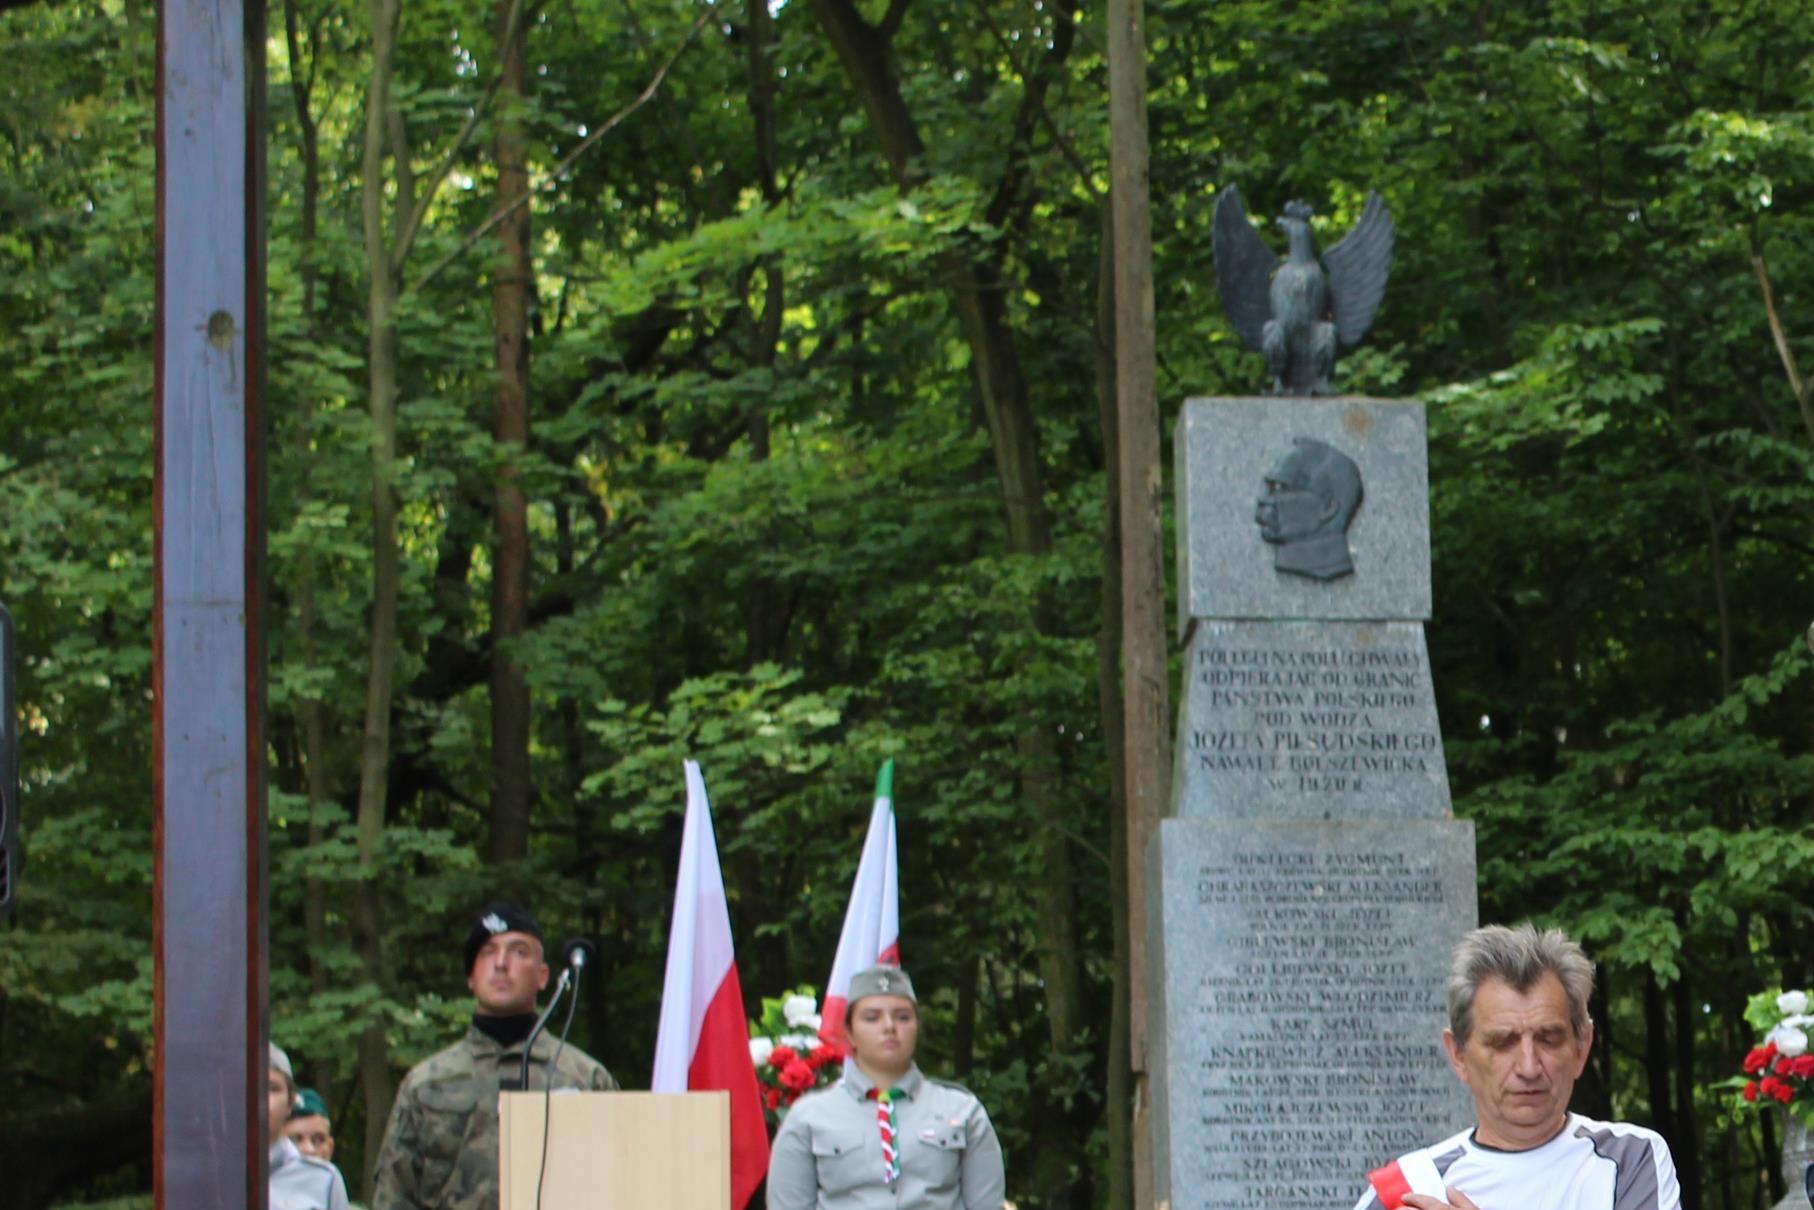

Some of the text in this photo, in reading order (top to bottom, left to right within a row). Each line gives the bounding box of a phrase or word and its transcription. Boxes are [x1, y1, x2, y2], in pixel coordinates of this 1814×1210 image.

[1271, 650, 1298, 666] NA
[1322, 672, 1348, 687] OD
[1353, 673, 1421, 689] GRANIC
[1314, 692, 1415, 709] POLSKIEGO
[1255, 712, 1293, 726] POD
[1325, 853, 1406, 865] ZYGMUNT
[1349, 881, 1444, 893] ALEKSANDER
[1335, 1046, 1439, 1059] ALEKSANDER
[1229, 1074, 1322, 1086] MAKOWSKI
[1363, 1129, 1425, 1142] ANTONI
